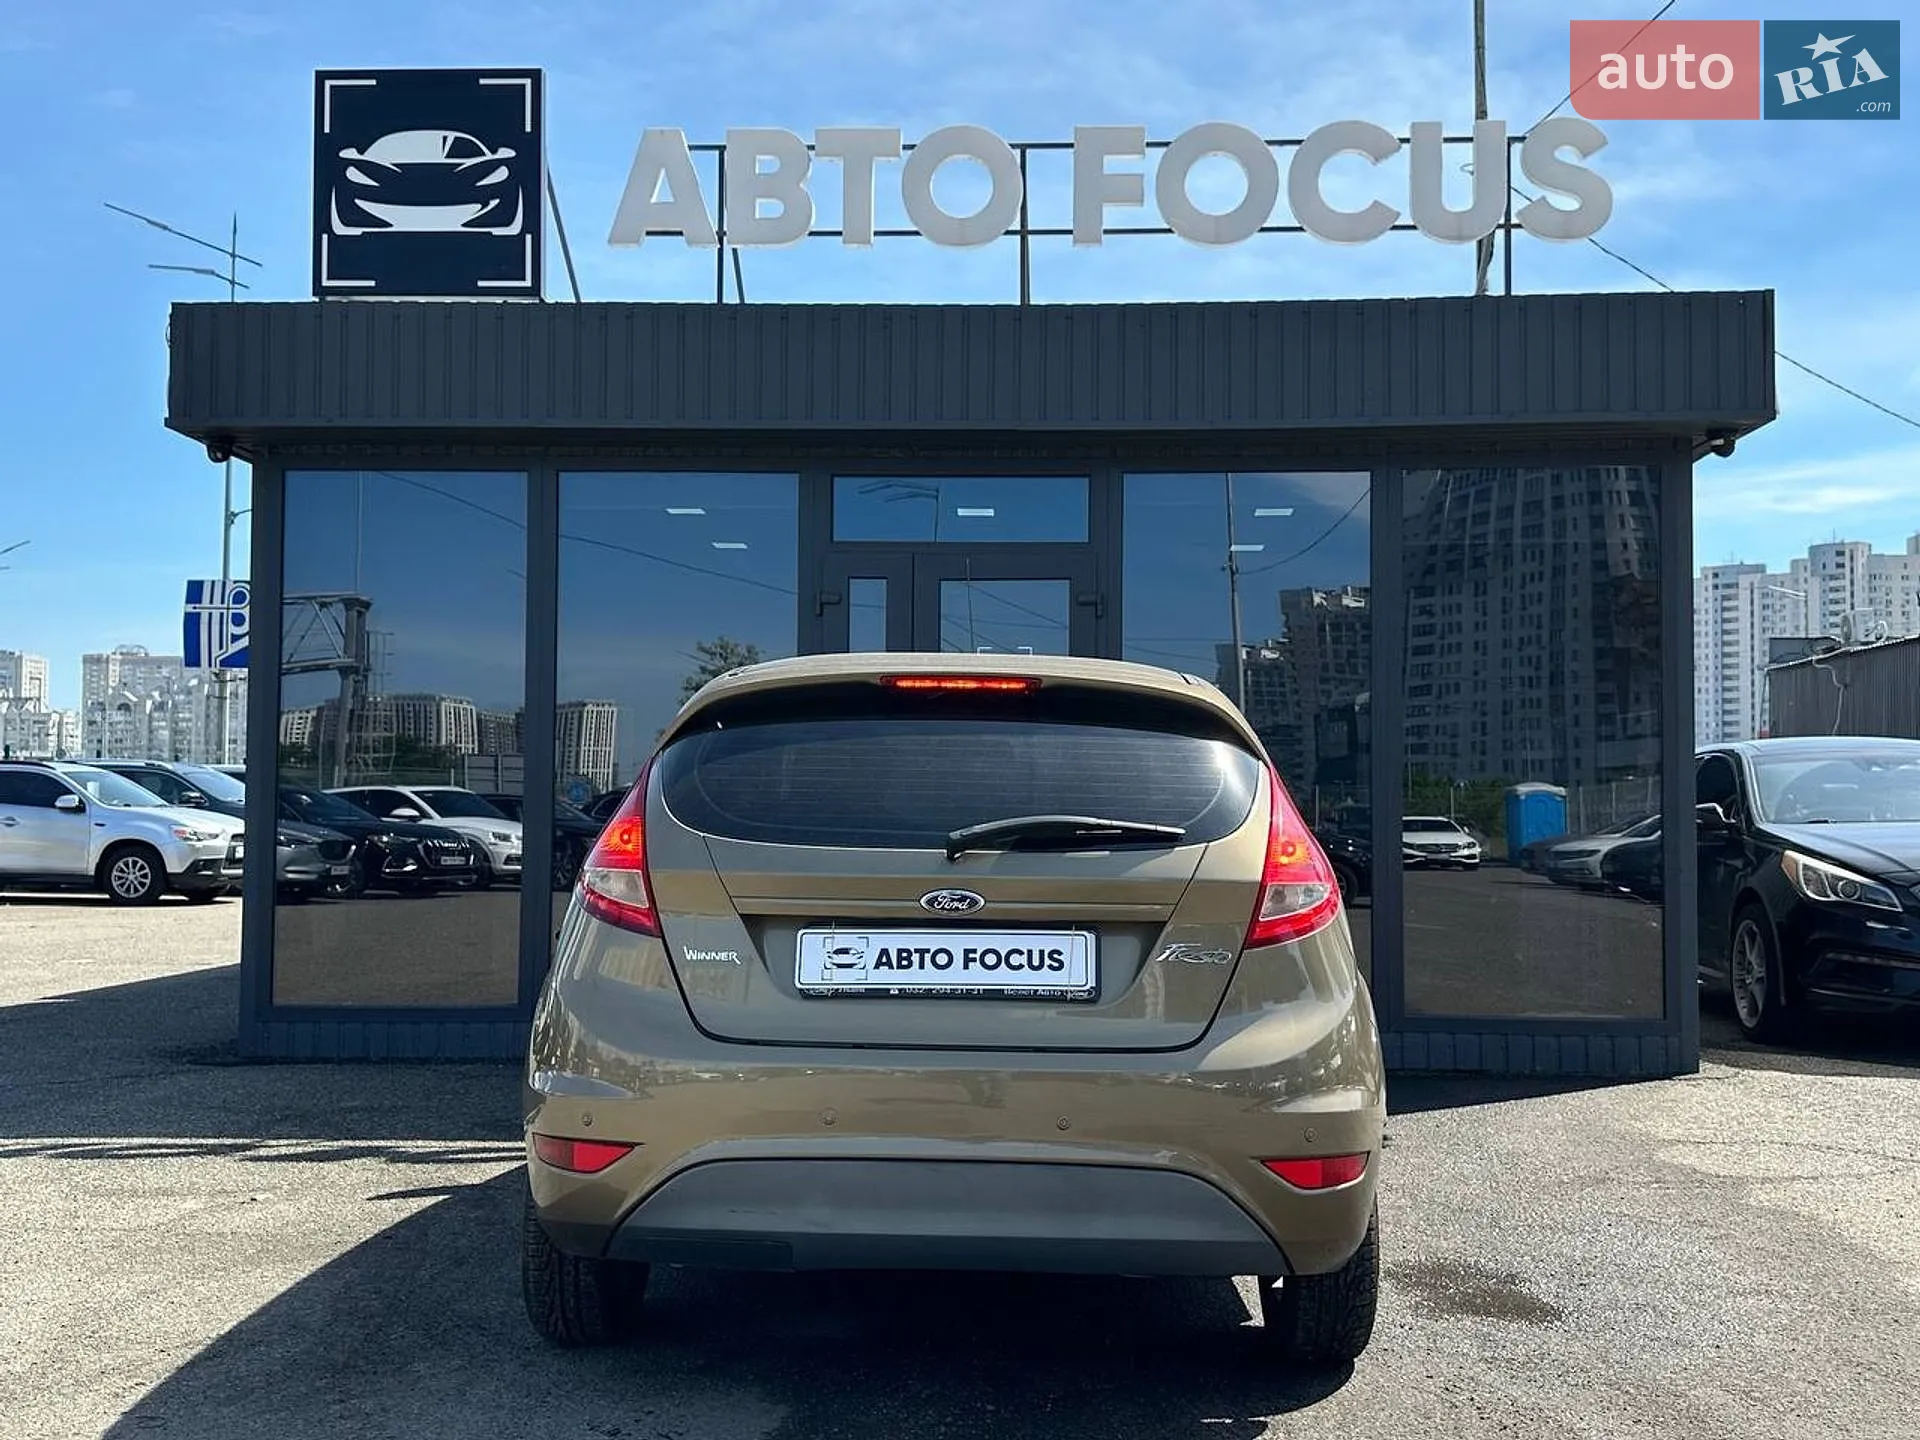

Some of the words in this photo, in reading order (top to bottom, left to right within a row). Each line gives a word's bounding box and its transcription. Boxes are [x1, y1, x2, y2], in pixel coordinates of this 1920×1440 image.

[607, 126, 1024, 249] АВТО
[1072, 119, 1613, 247] FOCUS
[873, 947, 954, 971] АВТО
[962, 947, 1065, 972] FOCUS
